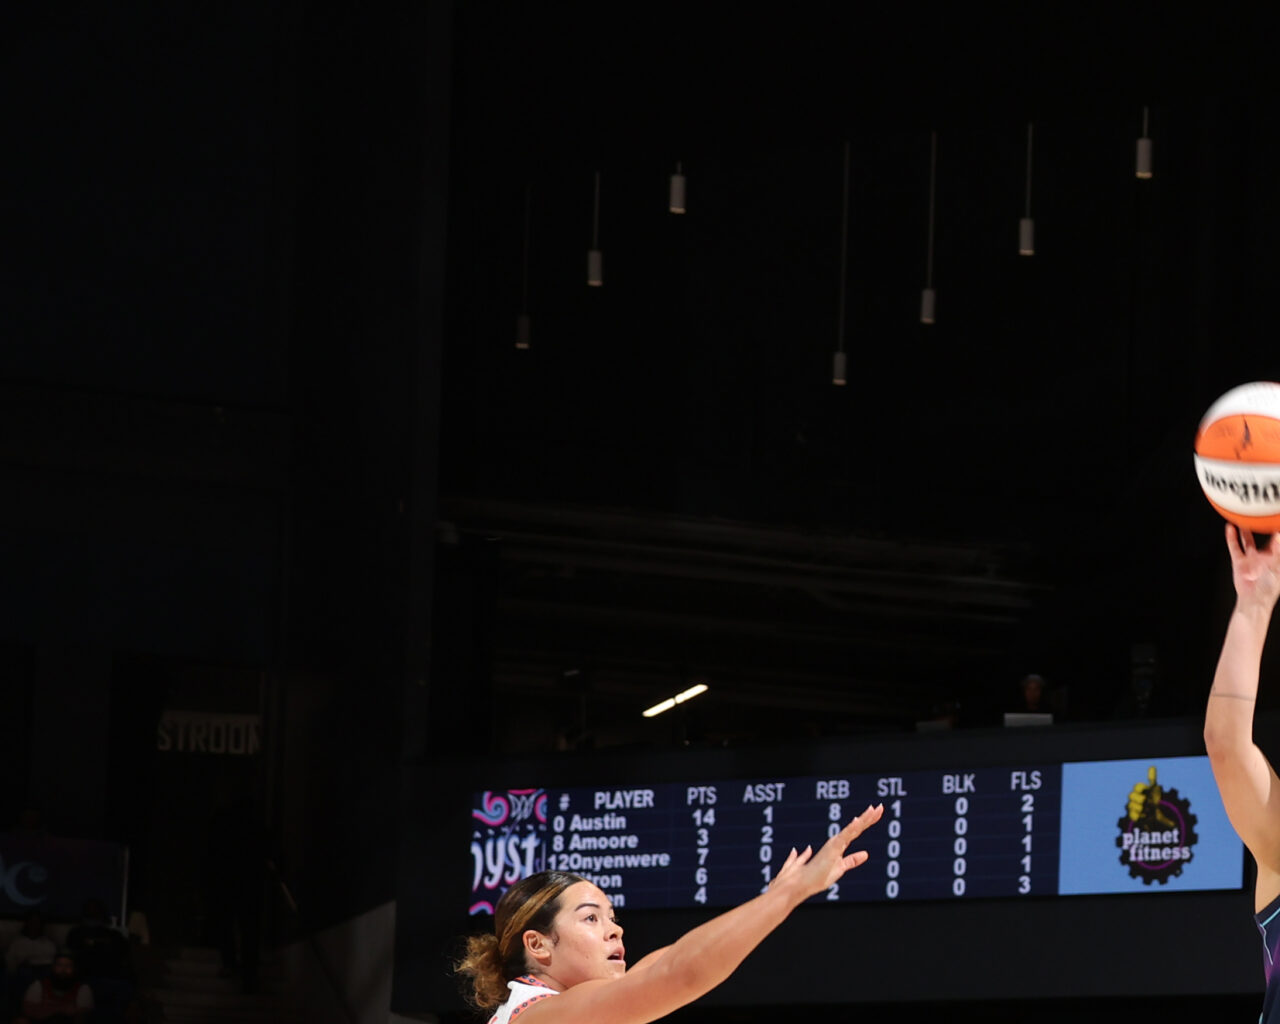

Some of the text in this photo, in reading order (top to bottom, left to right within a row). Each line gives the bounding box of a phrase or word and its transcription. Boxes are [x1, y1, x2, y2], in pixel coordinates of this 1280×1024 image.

[594, 789, 654, 809] PLAYER
[687, 786, 717, 805] PTS
[743, 783, 785, 802] ASST
[816, 780, 850, 799] REB
[877, 777, 907, 797] STL
[942, 774, 976, 794] BLK
[1011, 771, 1042, 790] FLS
[553, 815, 565, 832] 0
[569, 813, 626, 832] Austin
[692, 808, 716, 826] 14
[763, 806, 773, 823] 1
[829, 803, 841, 821] 8
[891, 800, 901, 818] 1
[955, 797, 968, 815] 0
[1021, 794, 1034, 812] 2
[552, 835, 564, 852] 8
[569, 833, 638, 851] Amoore
[697, 828, 709, 846] 3
[761, 826, 773, 843] 2
[888, 820, 901, 838] 0
[954, 817, 968, 835] 0
[1022, 814, 1033, 832] 1
[1122, 827, 1179, 850] planet
[697, 848, 709, 865] 7
[759, 846, 772, 863] 0
[887, 840, 900, 858] 0
[954, 837, 967, 855] 0
[1021, 834, 1032, 853] 1
[1129, 844, 1191, 862] fitness
[695, 867, 708, 885] 6
[761, 865, 771, 883] 1
[887, 860, 899, 878] 0
[953, 857, 966, 875] 0
[1021, 854, 1031, 873] 1
[694, 887, 707, 904] 4
[886, 880, 899, 898] 0
[953, 878, 966, 896] 0
[1018, 875, 1031, 894] 3
